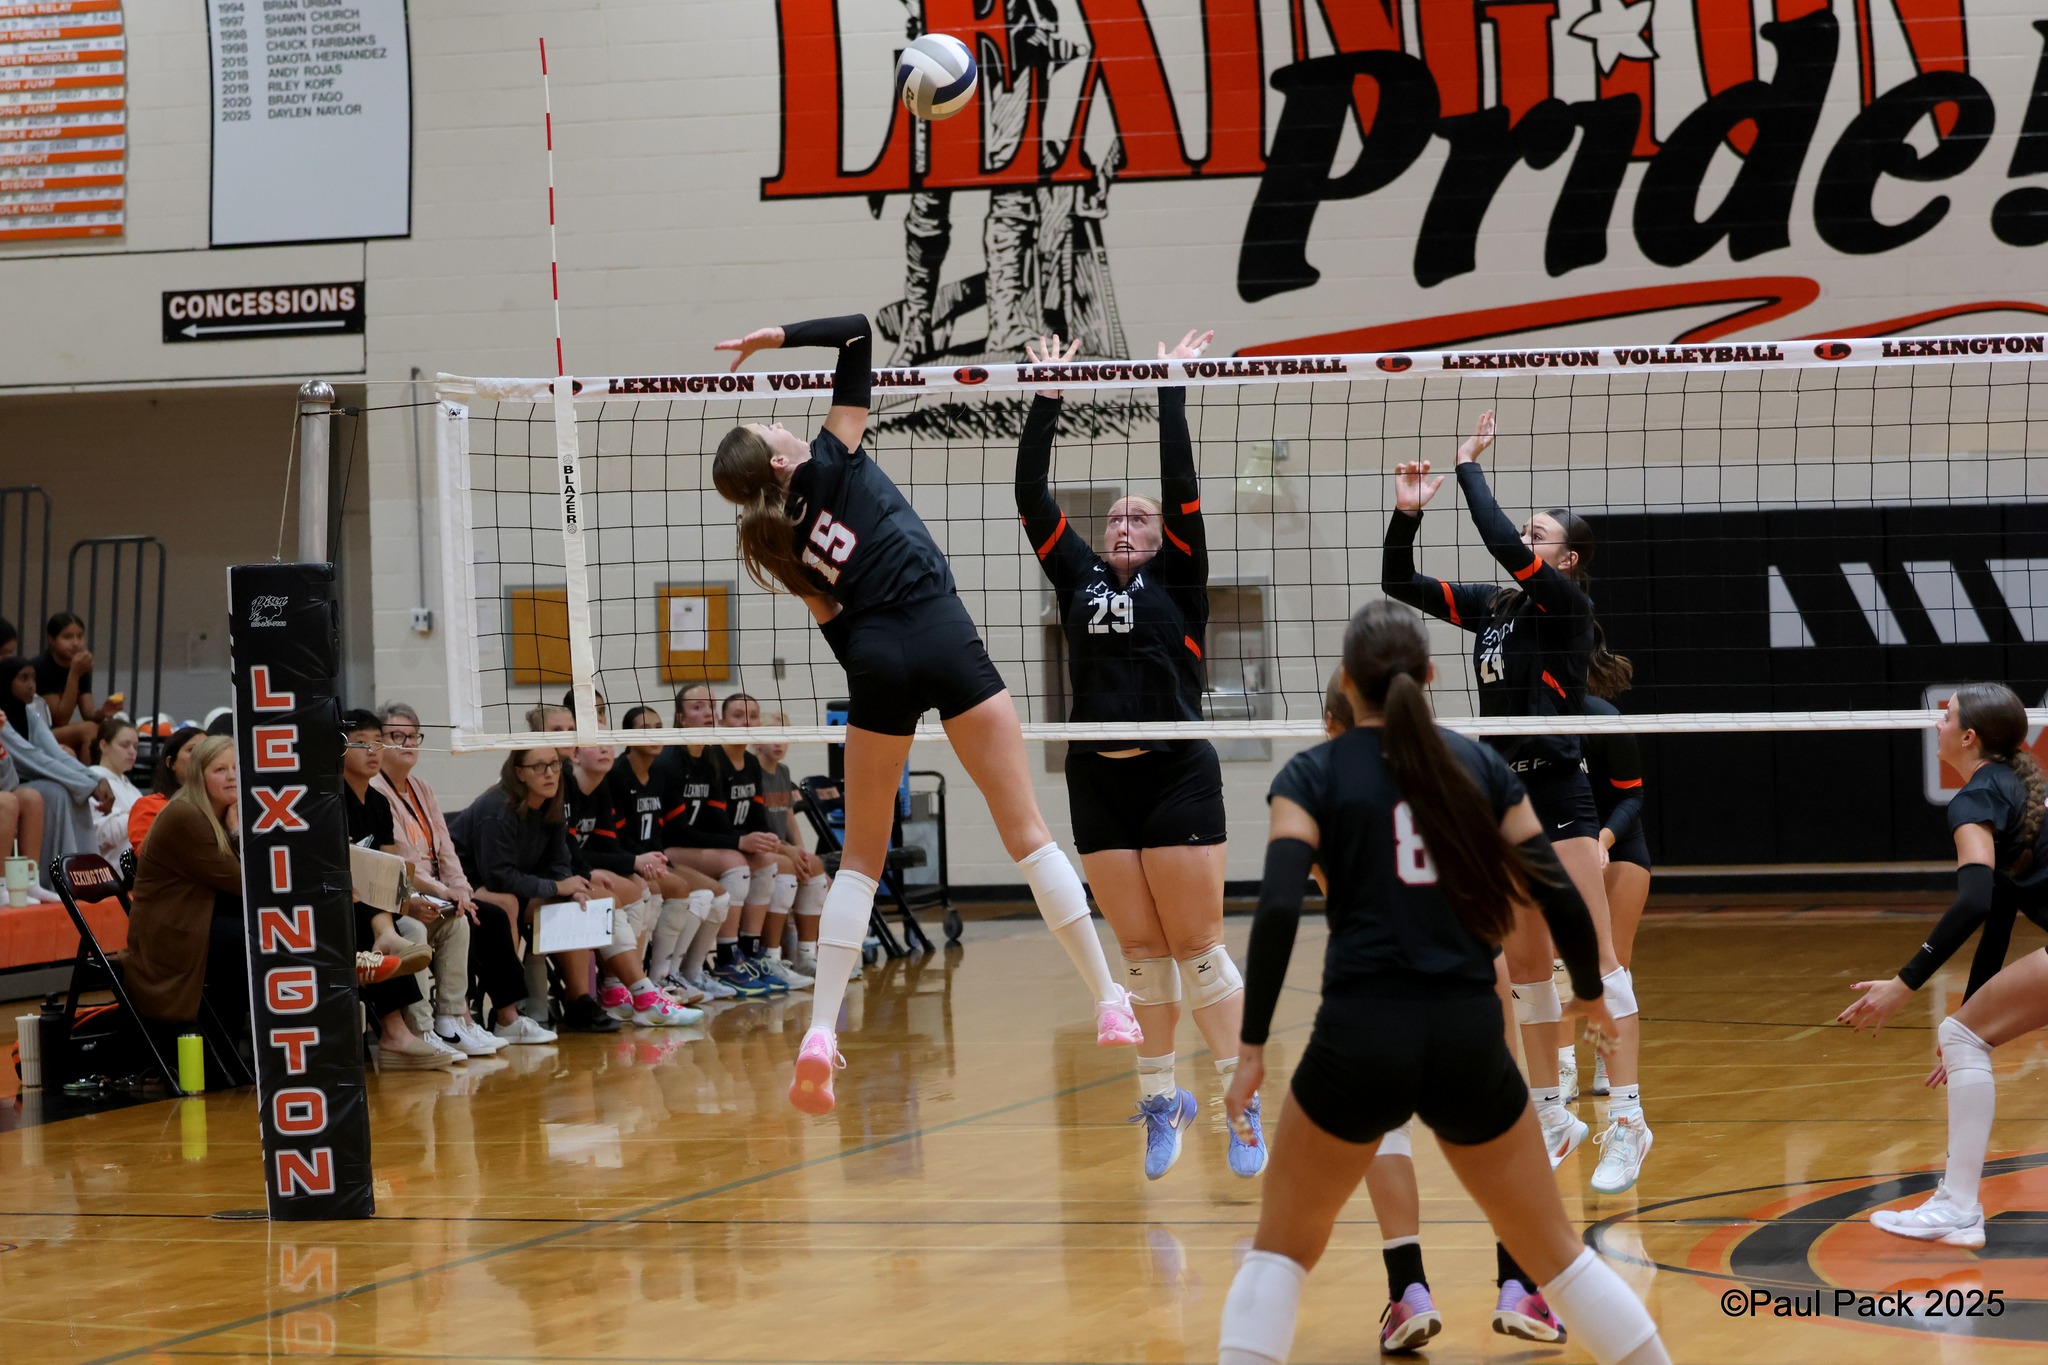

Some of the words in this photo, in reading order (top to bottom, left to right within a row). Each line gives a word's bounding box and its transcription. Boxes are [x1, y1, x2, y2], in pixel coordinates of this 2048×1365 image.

[218, 3, 244, 13] 1994
[263, 1, 298, 12] BRIAN
[219, 16, 244, 27] 1997
[264, 13, 306, 25] SHAWN
[310, 9, 360, 22] CHURCH
[220, 29, 247, 41] 1998
[265, 26, 307, 38] SHAWN
[311, 23, 361, 35] CHURCH
[221, 43, 248, 54] 1998
[266, 40, 307, 52] CHUCK
[312, 35, 376, 49] FAIRBANKS
[221, 57, 248, 68] 2015
[266, 53, 311, 65] DAKOTA
[316, 48, 387, 62] HERNANDEZ
[222, 70, 249, 81] 2018
[268, 67, 299, 78] ANDY
[304, 64, 342, 76] ROJAS
[222, 83, 249, 95] 2019
[267, 80, 300, 92] RILEY
[305, 77, 335, 89] KOPF
[222, 97, 252, 109] 2020
[268, 94, 307, 106] BRADY
[312, 91, 343, 103] FAGO
[222, 110, 251, 122] 2025
[268, 107, 312, 119] DAYLEN
[316, 104, 362, 116] NAYLOR
[168, 286, 356, 320] CONCESSIONS
[1441, 350, 1599, 370] LEXINGTON
[1613, 344, 1784, 365] VOLLEYBALL
[1881, 336, 2045, 357] LEXINGTON
[1016, 362, 1169, 383] LEXINGTON
[1181, 357, 1347, 378] VOLLEYBALL
[607, 374, 755, 395] LEXINGTON
[767, 369, 926, 391] VOLLBALL
[563, 465, 577, 523] BLAZER
[801, 508, 859, 587] 15
[1087, 594, 1134, 634] 29
[688, 800, 701, 826] 7
[733, 799, 751, 826] 10
[640, 812, 654, 841] 17
[69, 866, 114, 886] LEXINGTON
[249, 663, 337, 1199] LEXINGTON
